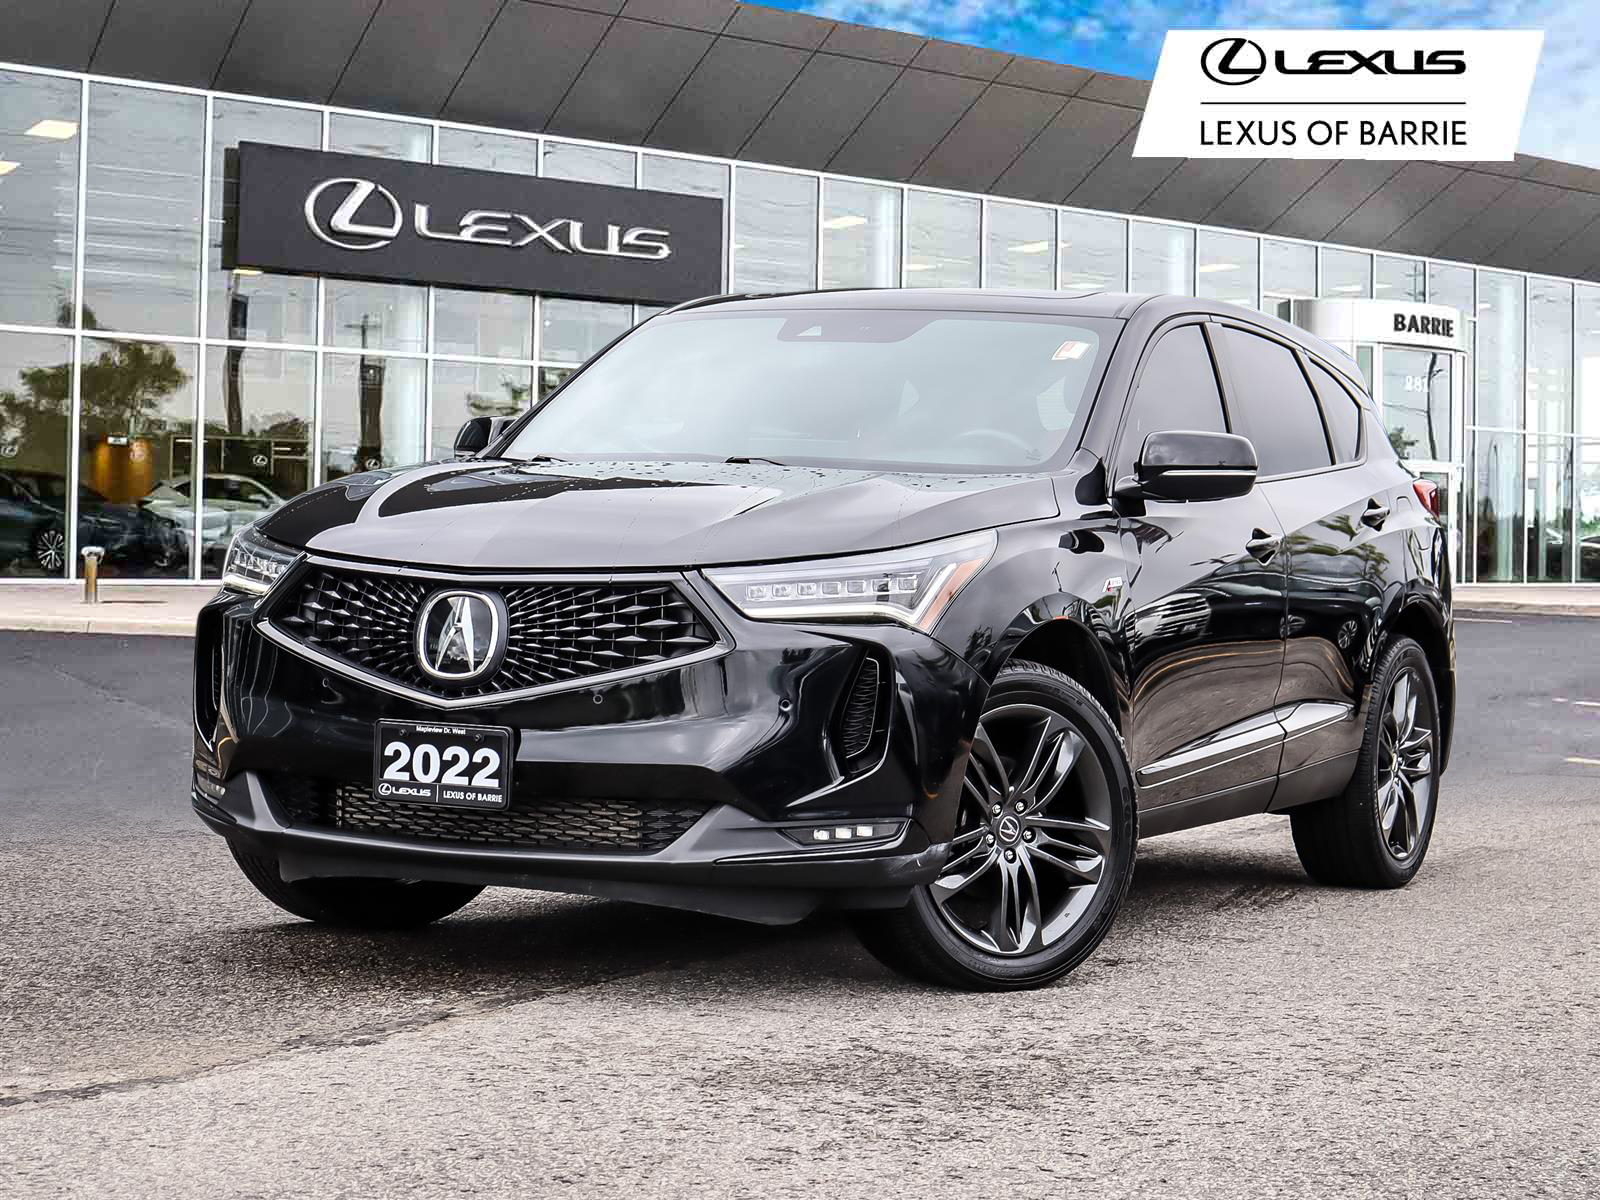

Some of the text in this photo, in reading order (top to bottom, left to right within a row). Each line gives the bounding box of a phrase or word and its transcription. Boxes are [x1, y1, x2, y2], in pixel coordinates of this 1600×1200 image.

[414, 202, 672, 261] LEXUS
[1393, 313, 1455, 338] BARRIE
[383, 741, 501, 788] 2022
[392, 786, 432, 797] LEXUS
[443, 790, 503, 803] LEXUS OF BARRIE
